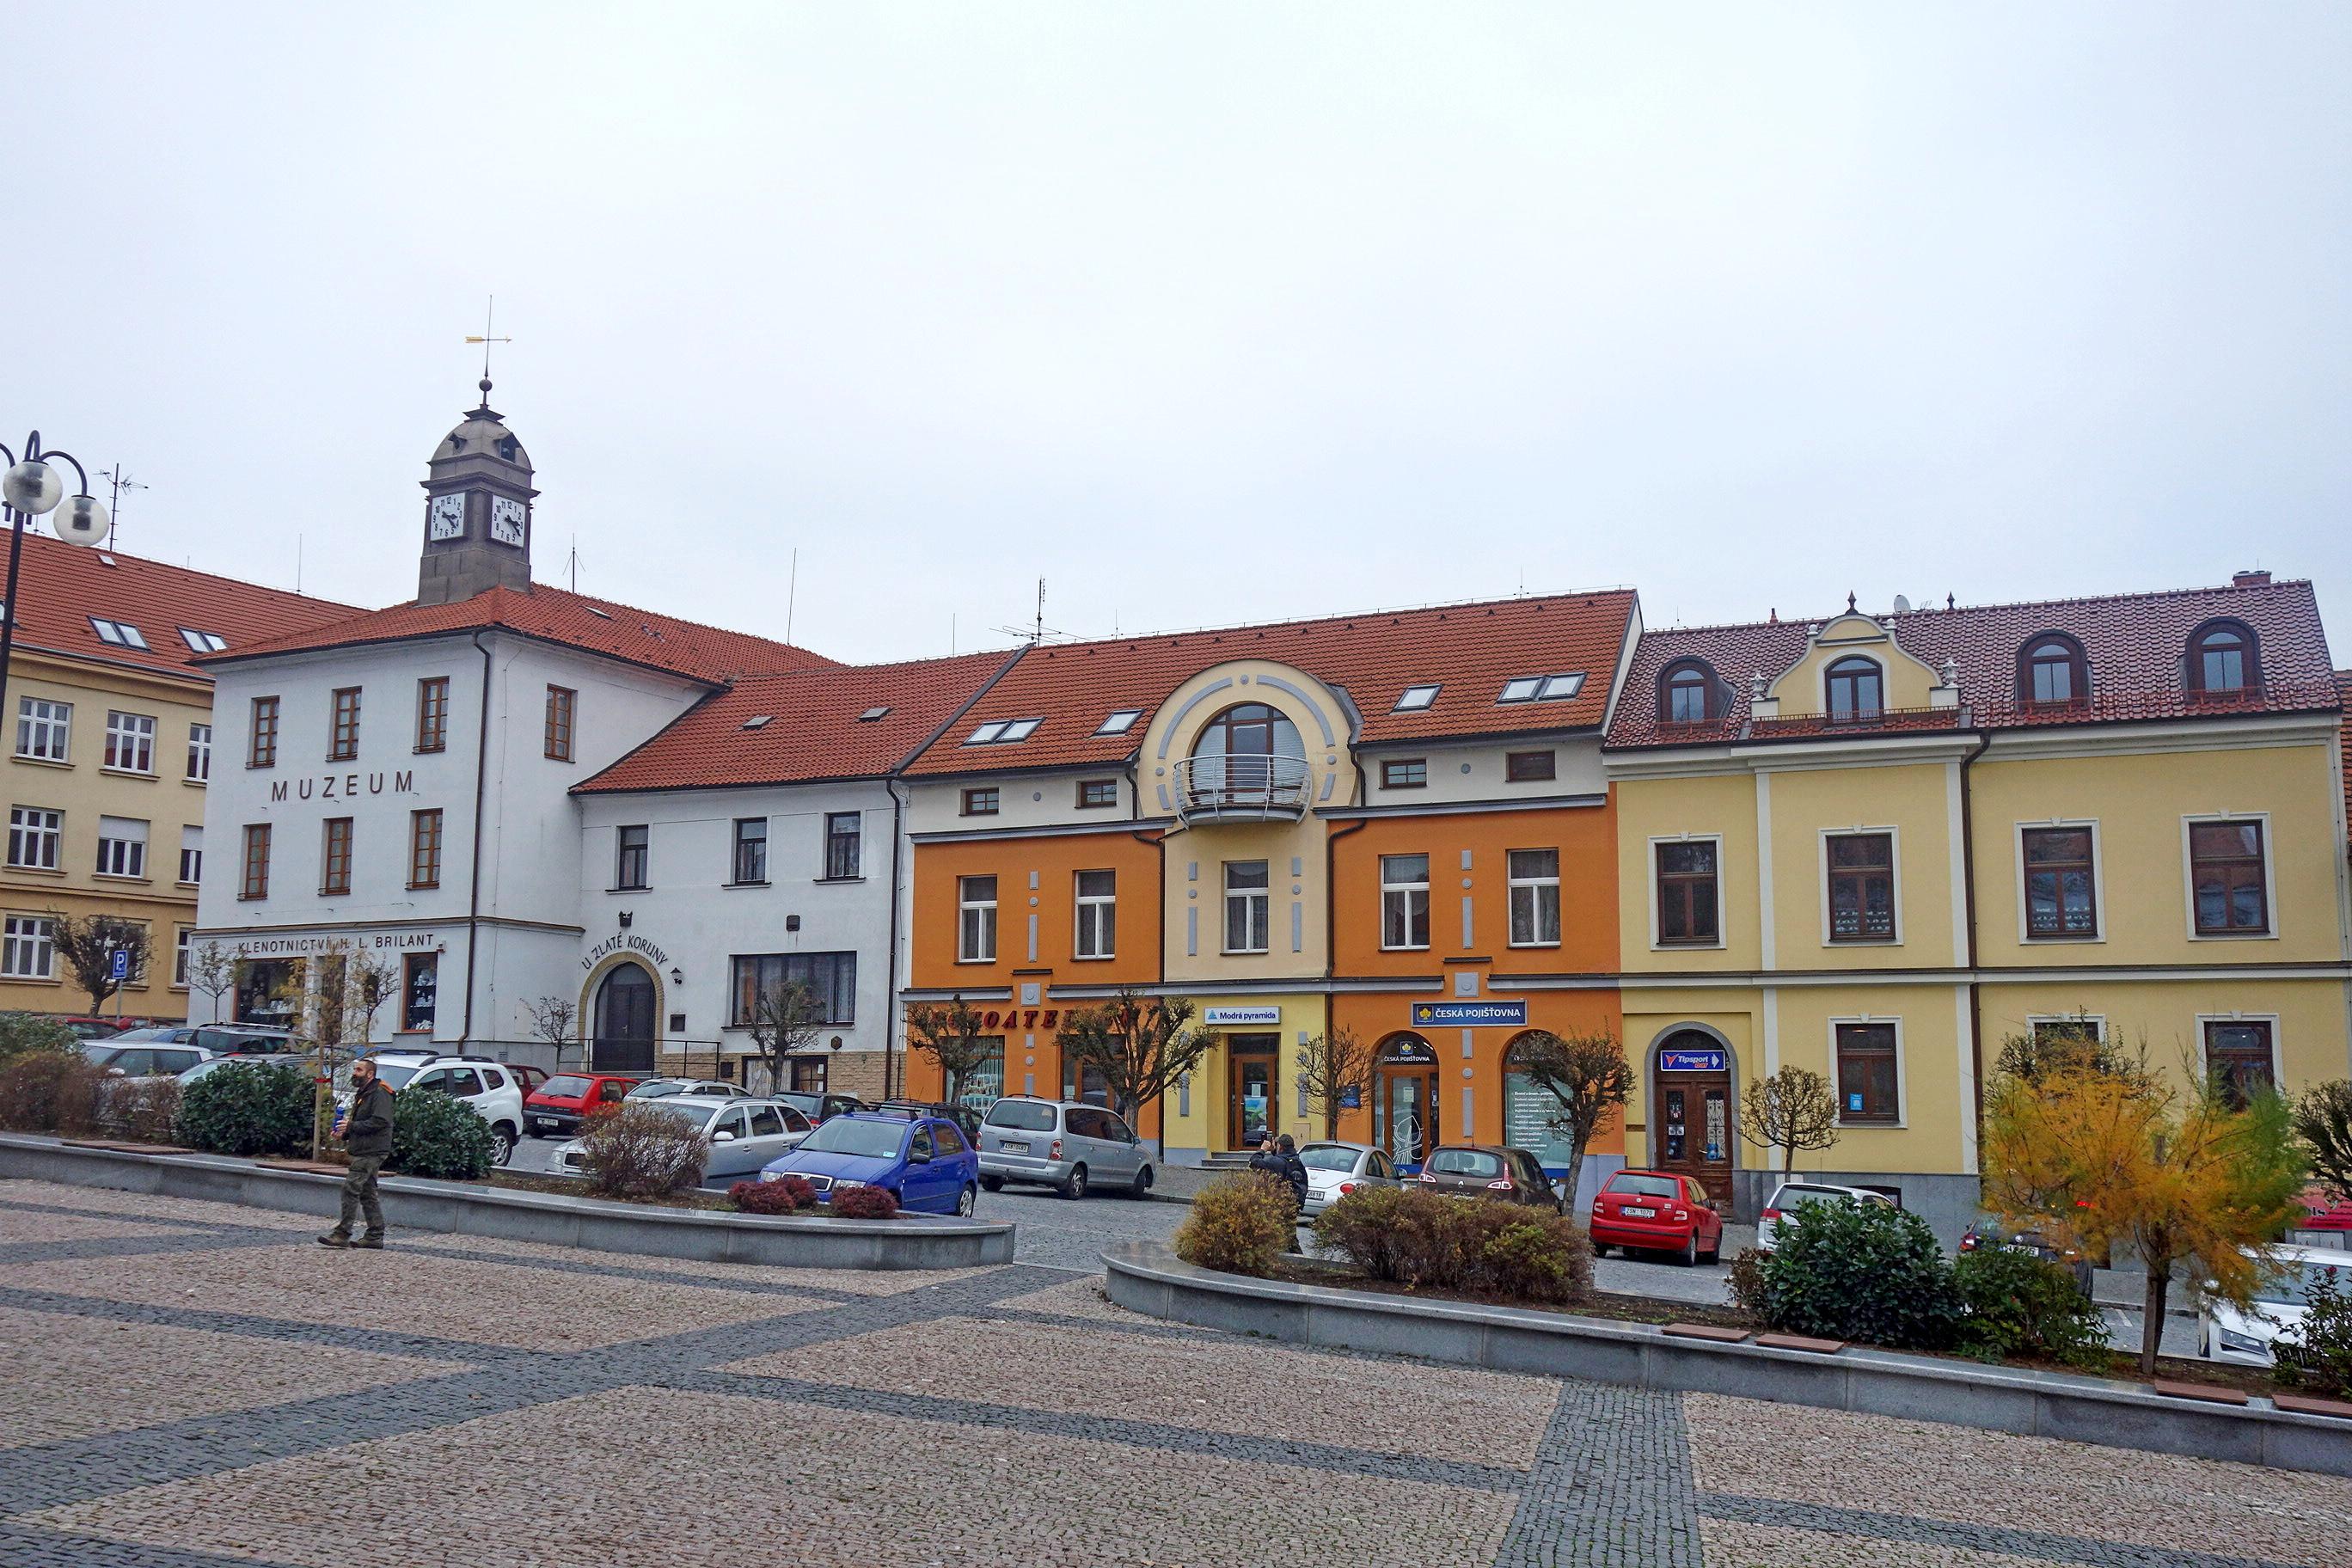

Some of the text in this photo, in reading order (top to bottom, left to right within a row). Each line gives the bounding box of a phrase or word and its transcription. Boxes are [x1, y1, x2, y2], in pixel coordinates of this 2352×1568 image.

[272, 770, 413, 801] MUZEUM
[358, 937, 368, 948] L.
[376, 934, 434, 948] BRILANT
[581, 931, 668, 970] U ZLATÉ KORUNY
[116, 954, 125, 970] P
[1243, 1012, 1276, 1020] pyramida
[1435, 1007, 1521, 1018] ČESKÁ POJIŠŤOVNA
[1678, 1055, 1709, 1064] Tipsport
